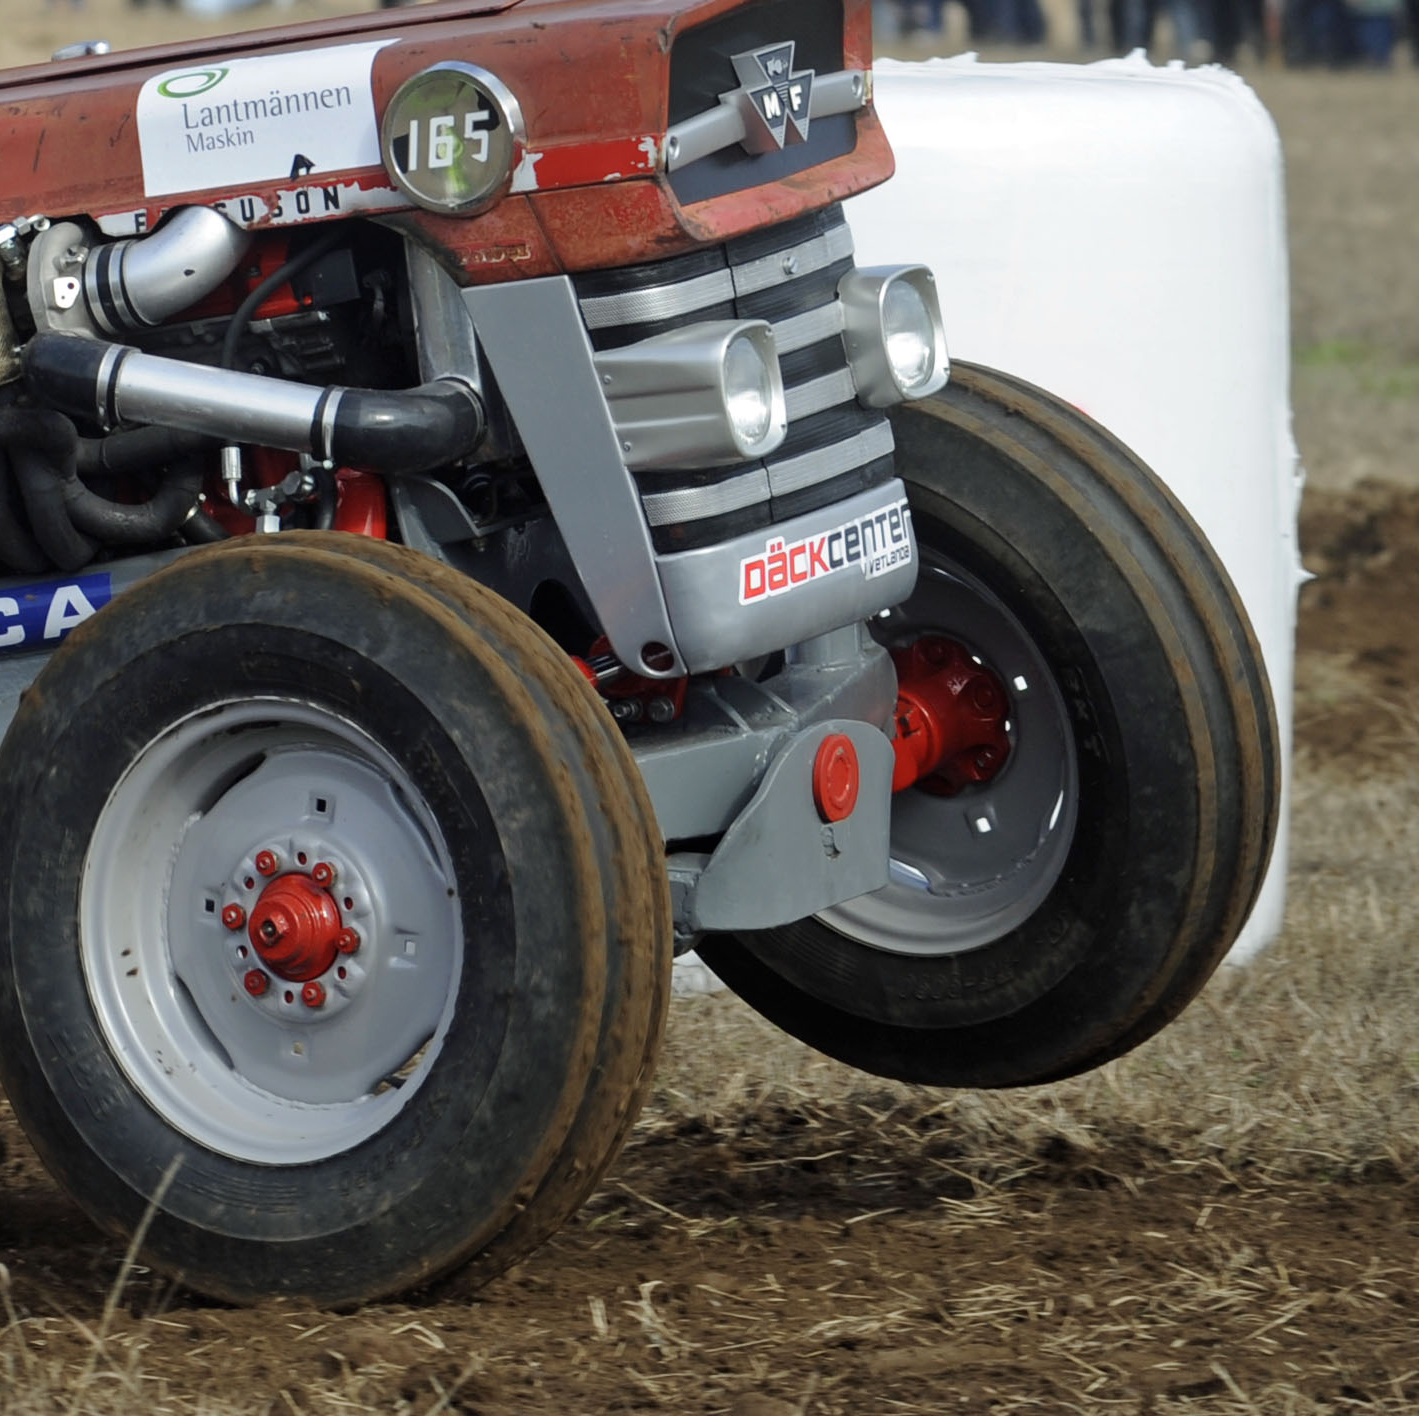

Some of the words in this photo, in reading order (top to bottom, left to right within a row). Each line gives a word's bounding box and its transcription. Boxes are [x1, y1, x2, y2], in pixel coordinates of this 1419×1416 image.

[182, 86, 352, 130] Lantmännen
[185, 126, 255, 154] Maskin
[408, 110, 490, 172] 165
